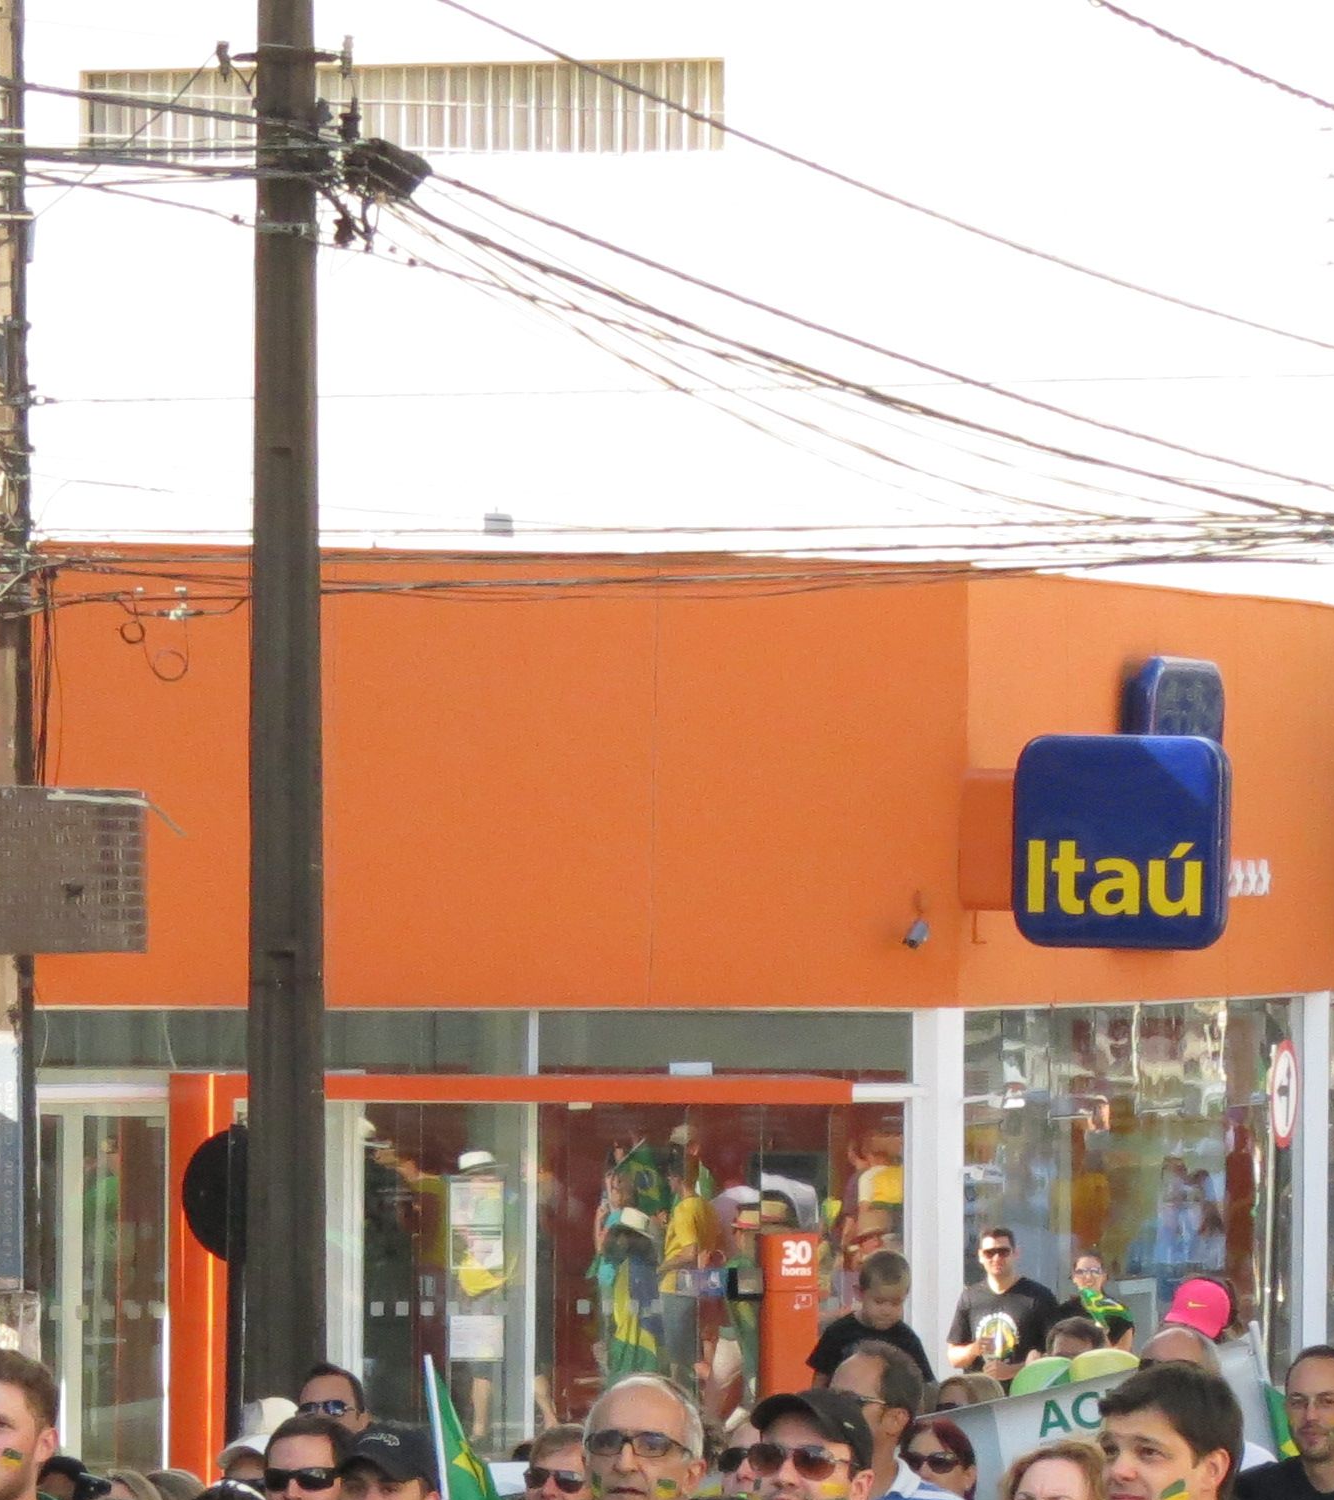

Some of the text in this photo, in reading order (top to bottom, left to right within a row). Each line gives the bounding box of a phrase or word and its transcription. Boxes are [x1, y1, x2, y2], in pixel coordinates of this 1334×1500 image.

[1027, 839, 1203, 918] Itaú
[781, 1240, 812, 1265] 30
[1039, 1390, 1104, 1438] AC
